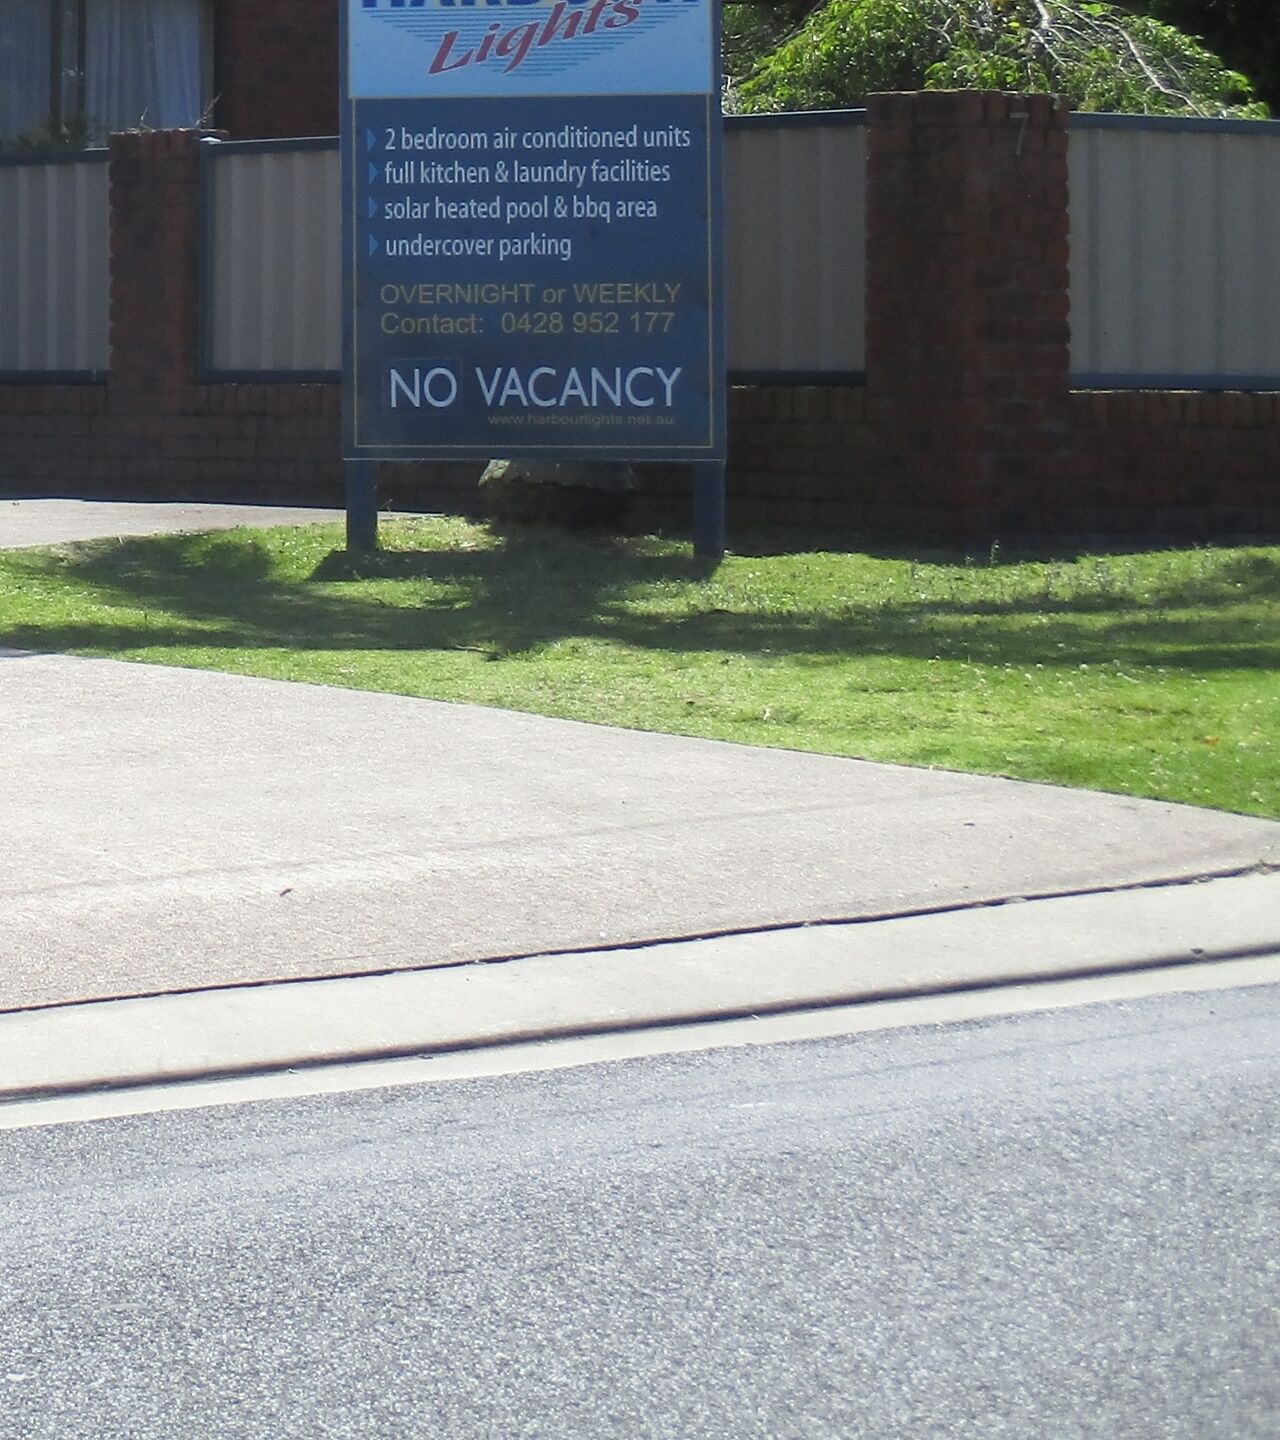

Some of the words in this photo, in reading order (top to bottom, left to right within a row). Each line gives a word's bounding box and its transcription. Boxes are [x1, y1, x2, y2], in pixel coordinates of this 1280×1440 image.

[384, 128, 396, 150] 2
[401, 127, 488, 150] bedroom
[493, 127, 518, 149] air
[522, 125, 638, 149] conditioned
[643, 126, 691, 148] units
[384, 160, 415, 184] full
[420, 160, 490, 183] kitchen
[495, 161, 509, 183] &
[514, 160, 586, 188] laundry
[591, 159, 671, 182] facilities
[384, 196, 429, 219] solar
[435, 196, 501, 219] heated
[506, 195, 548, 224] pool
[554, 196, 568, 218] &
[573, 195, 611, 223] bbq
[616, 199, 658, 218] area
[386, 234, 493, 256] undercover
[499, 232, 572, 261] parking
[380, 284, 536, 305] OVERNIGHT
[542, 287, 567, 304] or
[573, 283, 681, 304] WEEKLY
[380, 313, 484, 334] Contact:
[501, 312, 564, 334] 0428
[572, 312, 620, 334] 952
[630, 311, 676, 333] 177
[390, 367, 458, 408] NO
[475, 367, 682, 407] VACANCY
